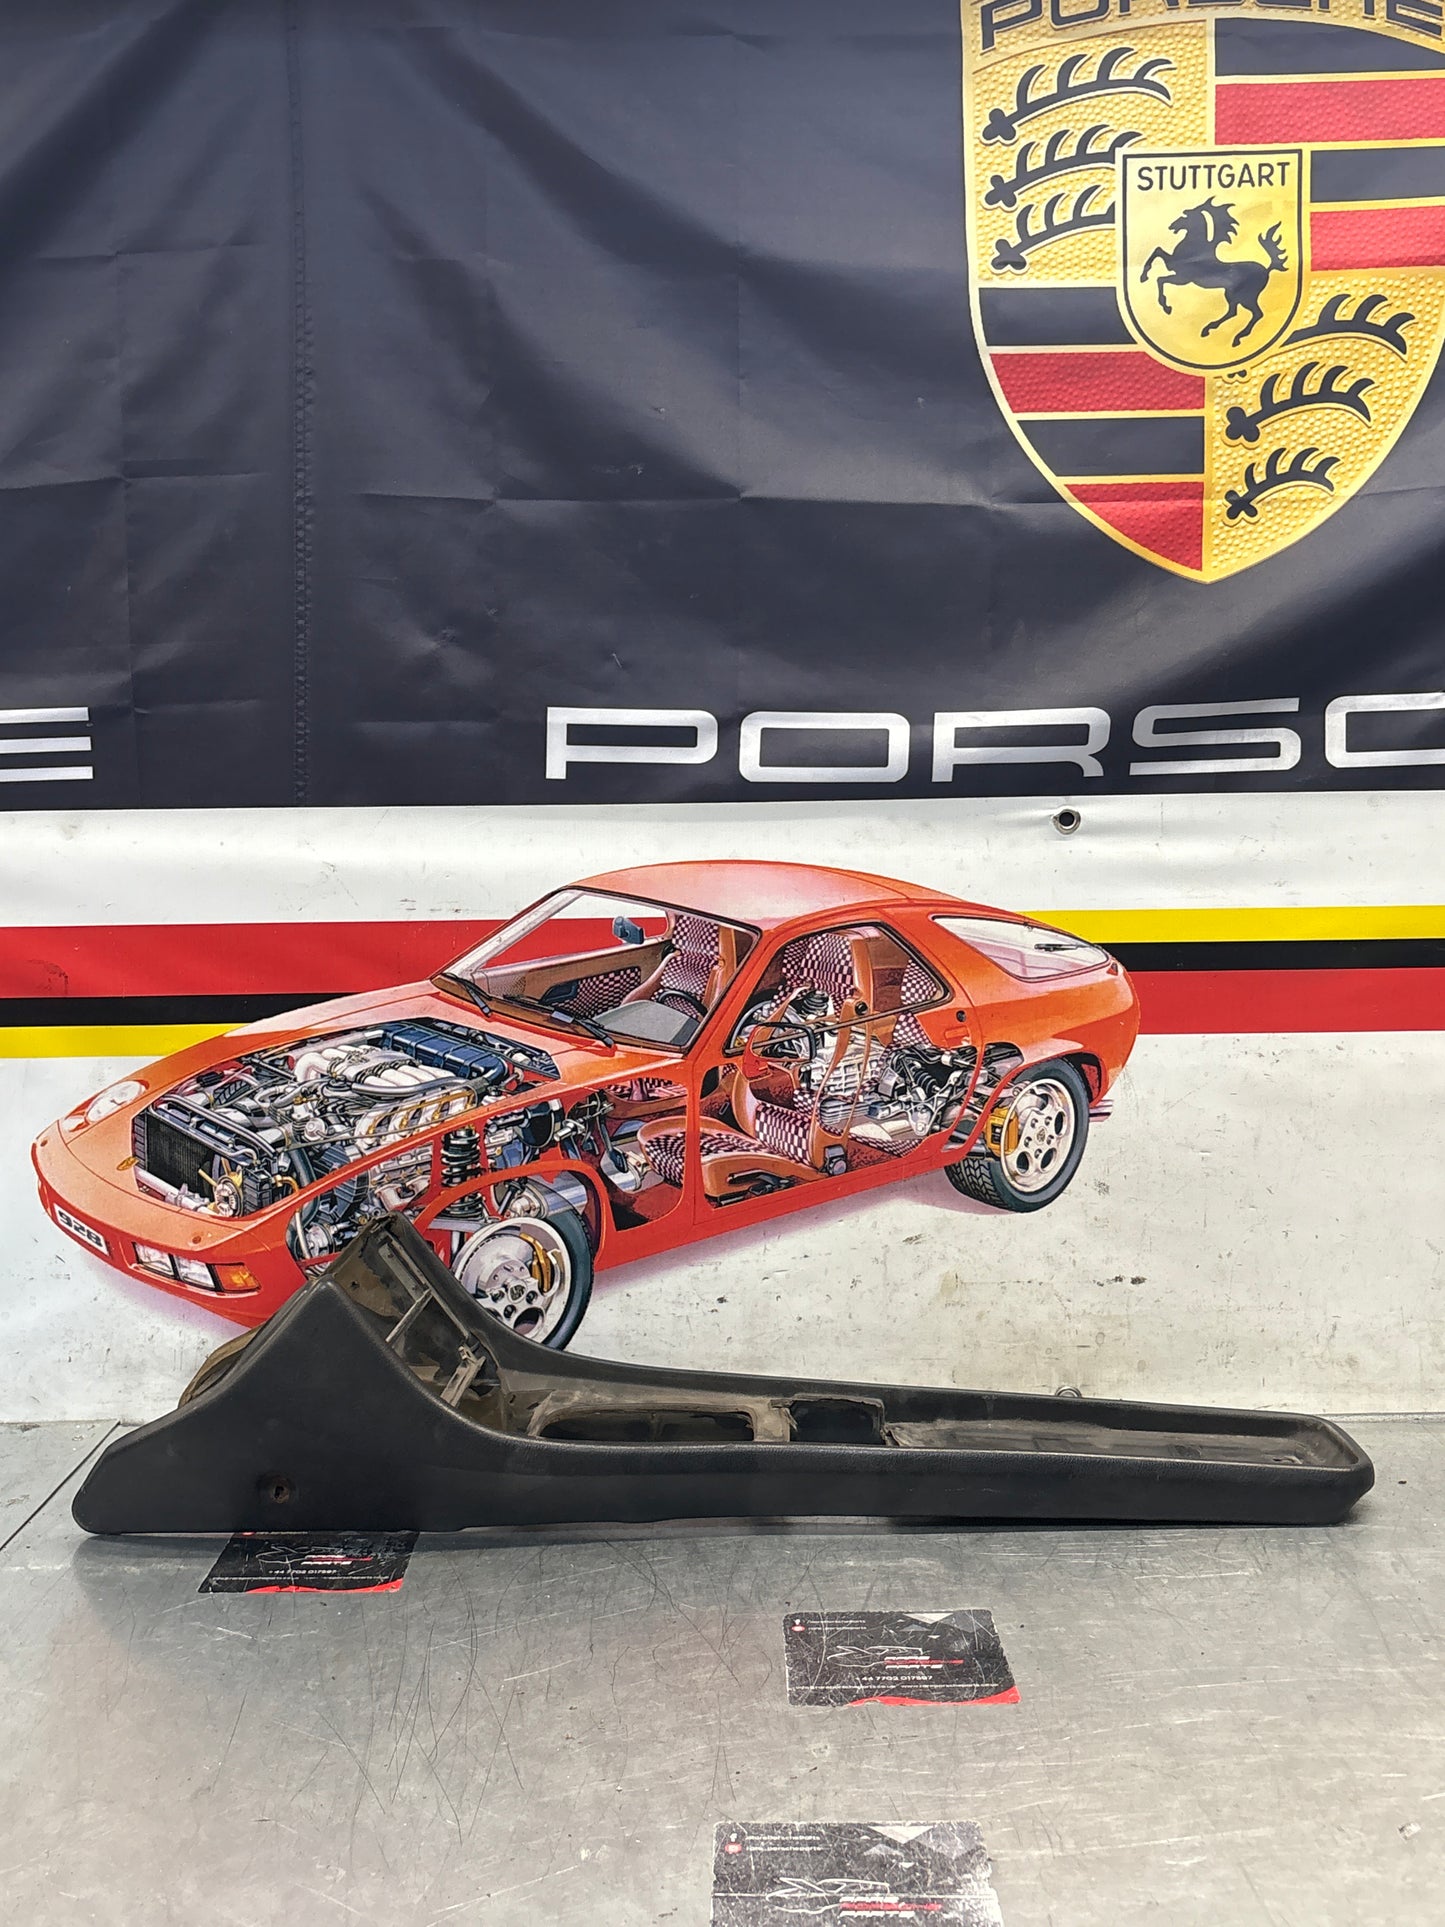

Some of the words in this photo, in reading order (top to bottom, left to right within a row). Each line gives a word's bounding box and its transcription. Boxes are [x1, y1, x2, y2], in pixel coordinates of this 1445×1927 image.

[1137, 161, 1291, 191] STUTTGART
[545, 691, 1445, 784] PORSC
[57, 1209, 103, 1248] 928
